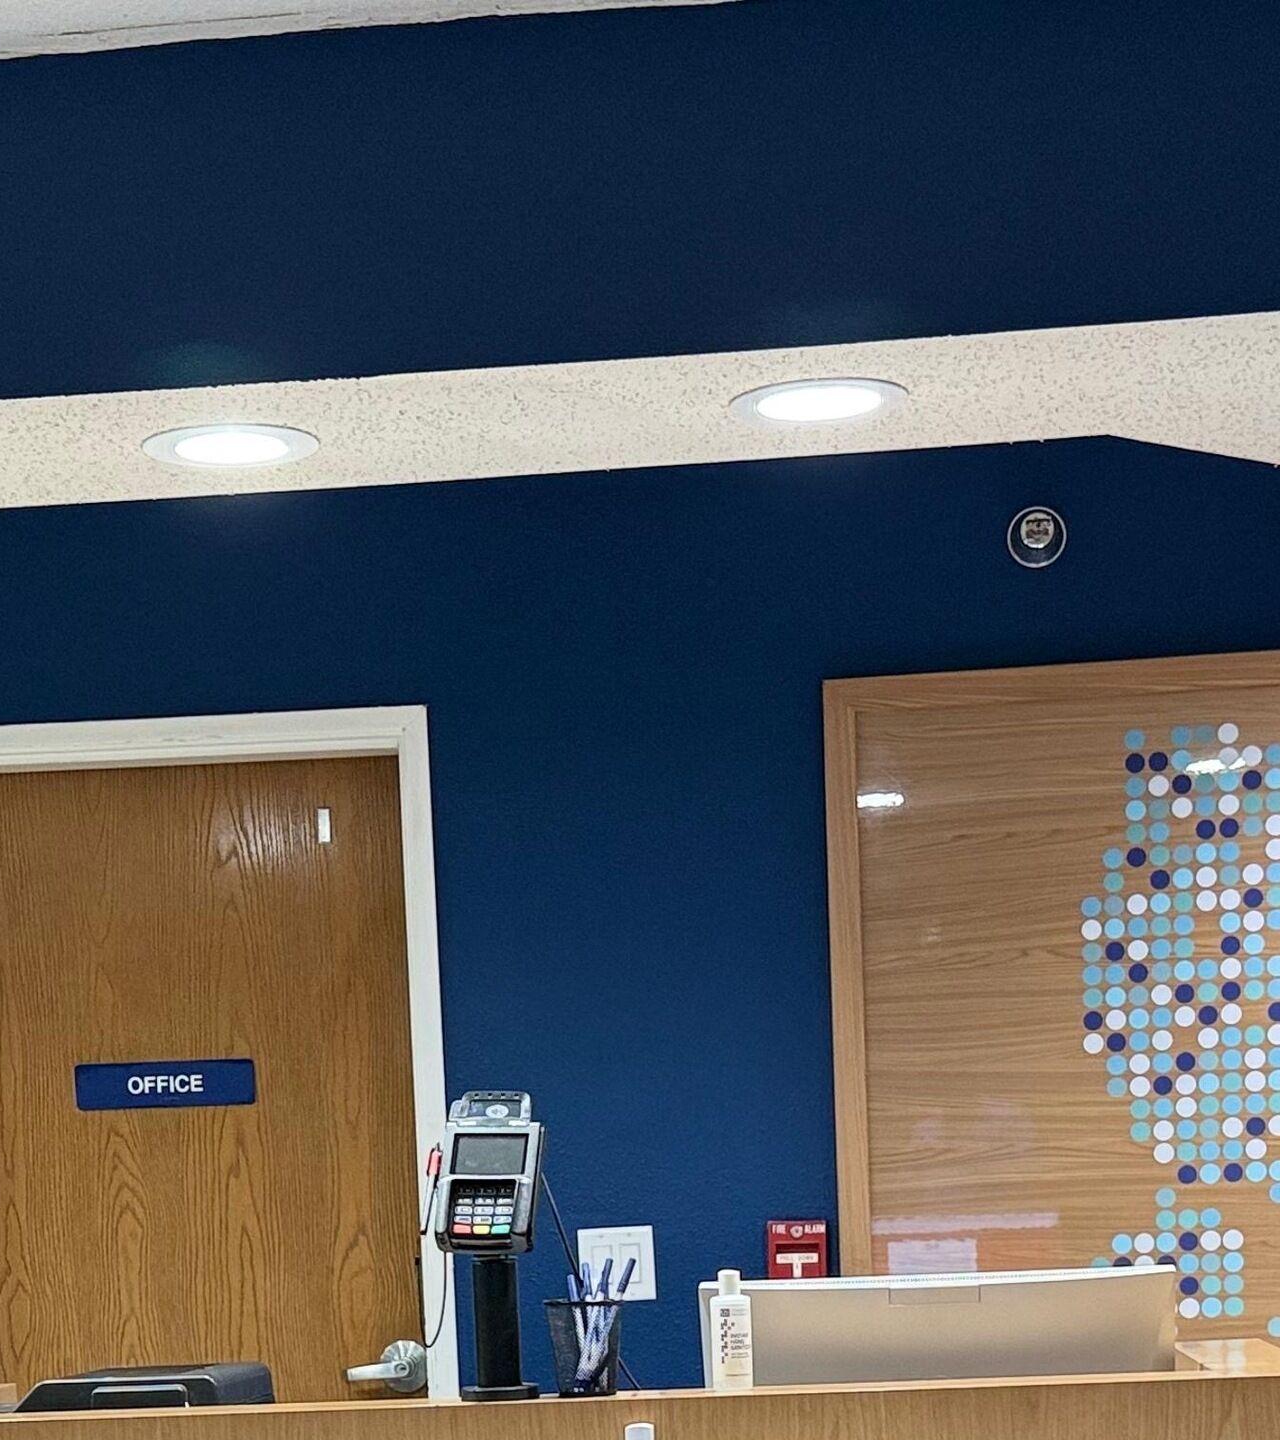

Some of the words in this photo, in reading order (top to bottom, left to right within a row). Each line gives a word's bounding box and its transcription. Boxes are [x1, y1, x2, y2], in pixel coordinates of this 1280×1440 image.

[127, 1074, 204, 1095] OFFICE
[772, 1224, 787, 1234] FIRE
[804, 1224, 826, 1234] ALARM
